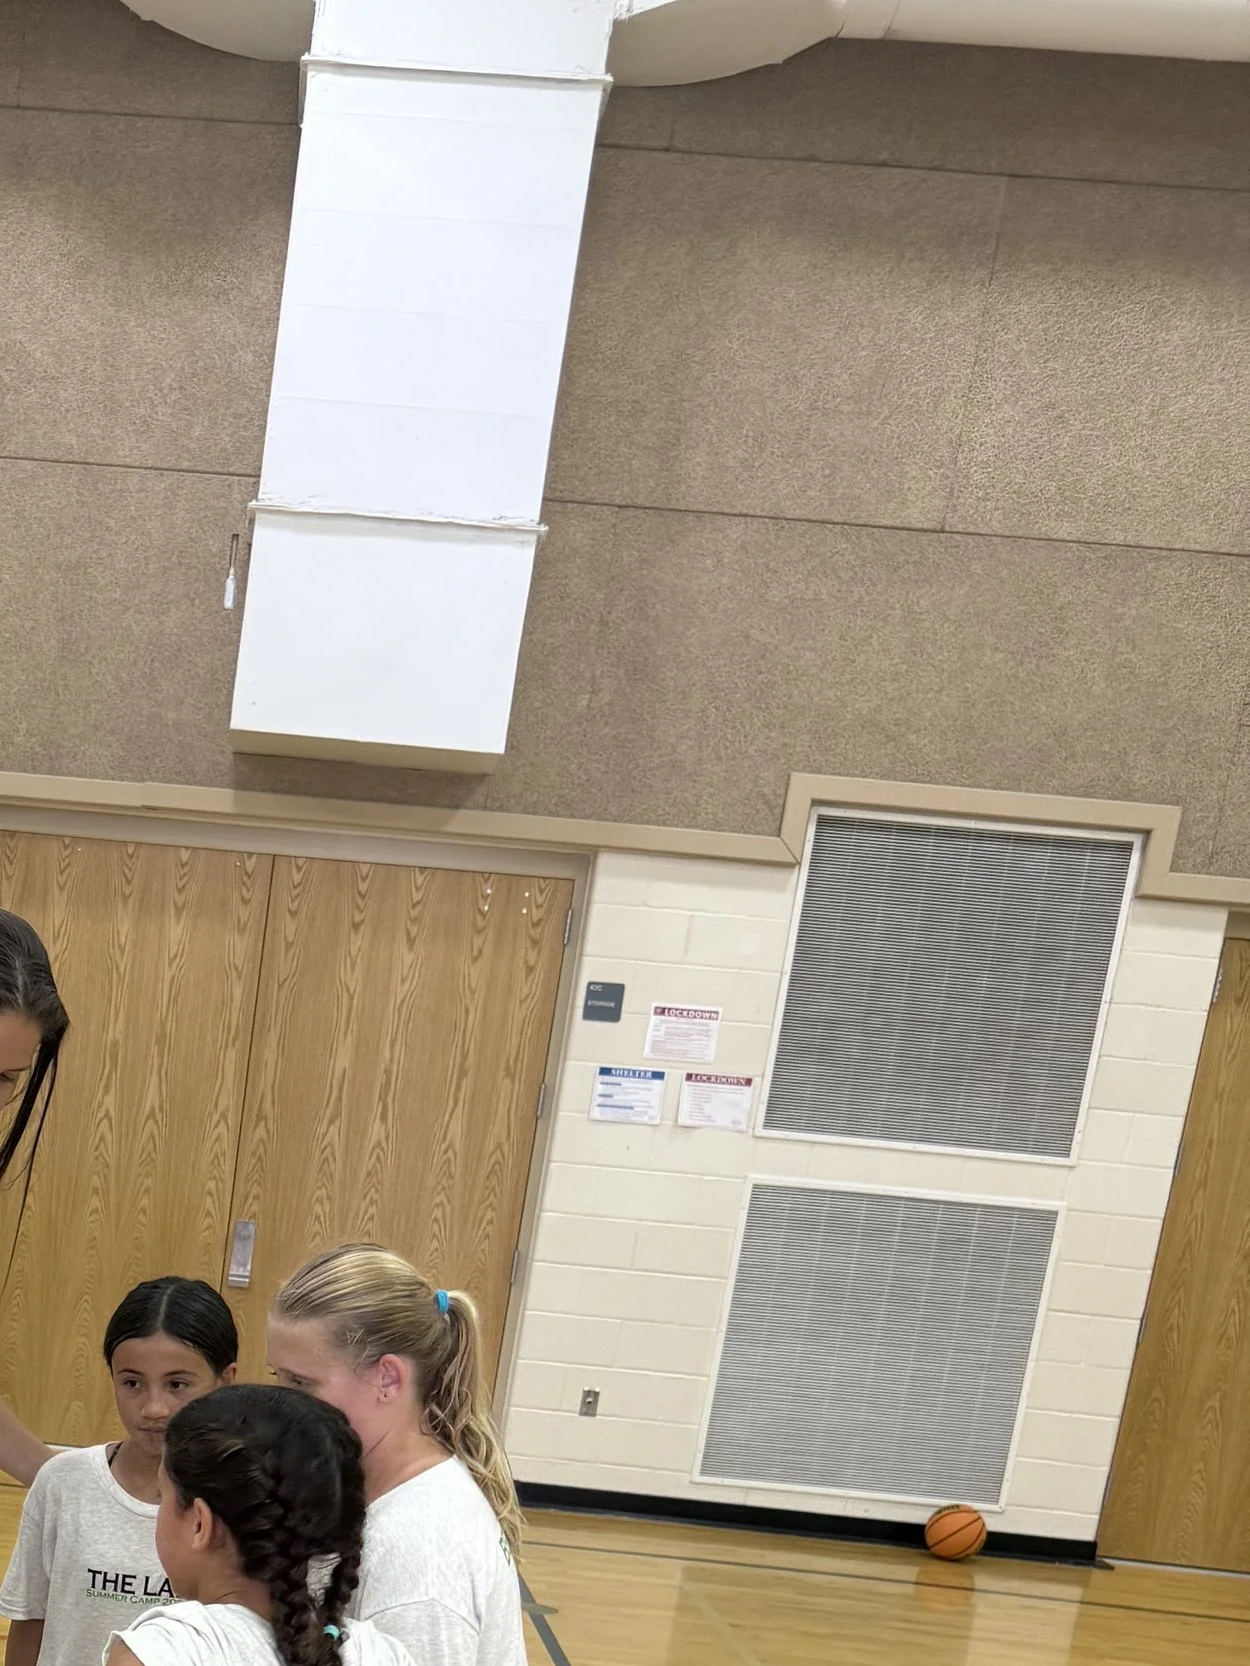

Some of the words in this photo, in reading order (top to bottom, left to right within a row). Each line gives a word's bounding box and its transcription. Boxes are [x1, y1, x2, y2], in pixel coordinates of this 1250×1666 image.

[664, 1008, 718, 1020] LOCKDOWN
[611, 1069, 652, 1079] SHELTER
[691, 1074, 747, 1086] LOCKDOWN
[87, 1568, 137, 1595] THE
[86, 1588, 128, 1602] SUMMER
[130, 1595, 161, 1605] CAMP
